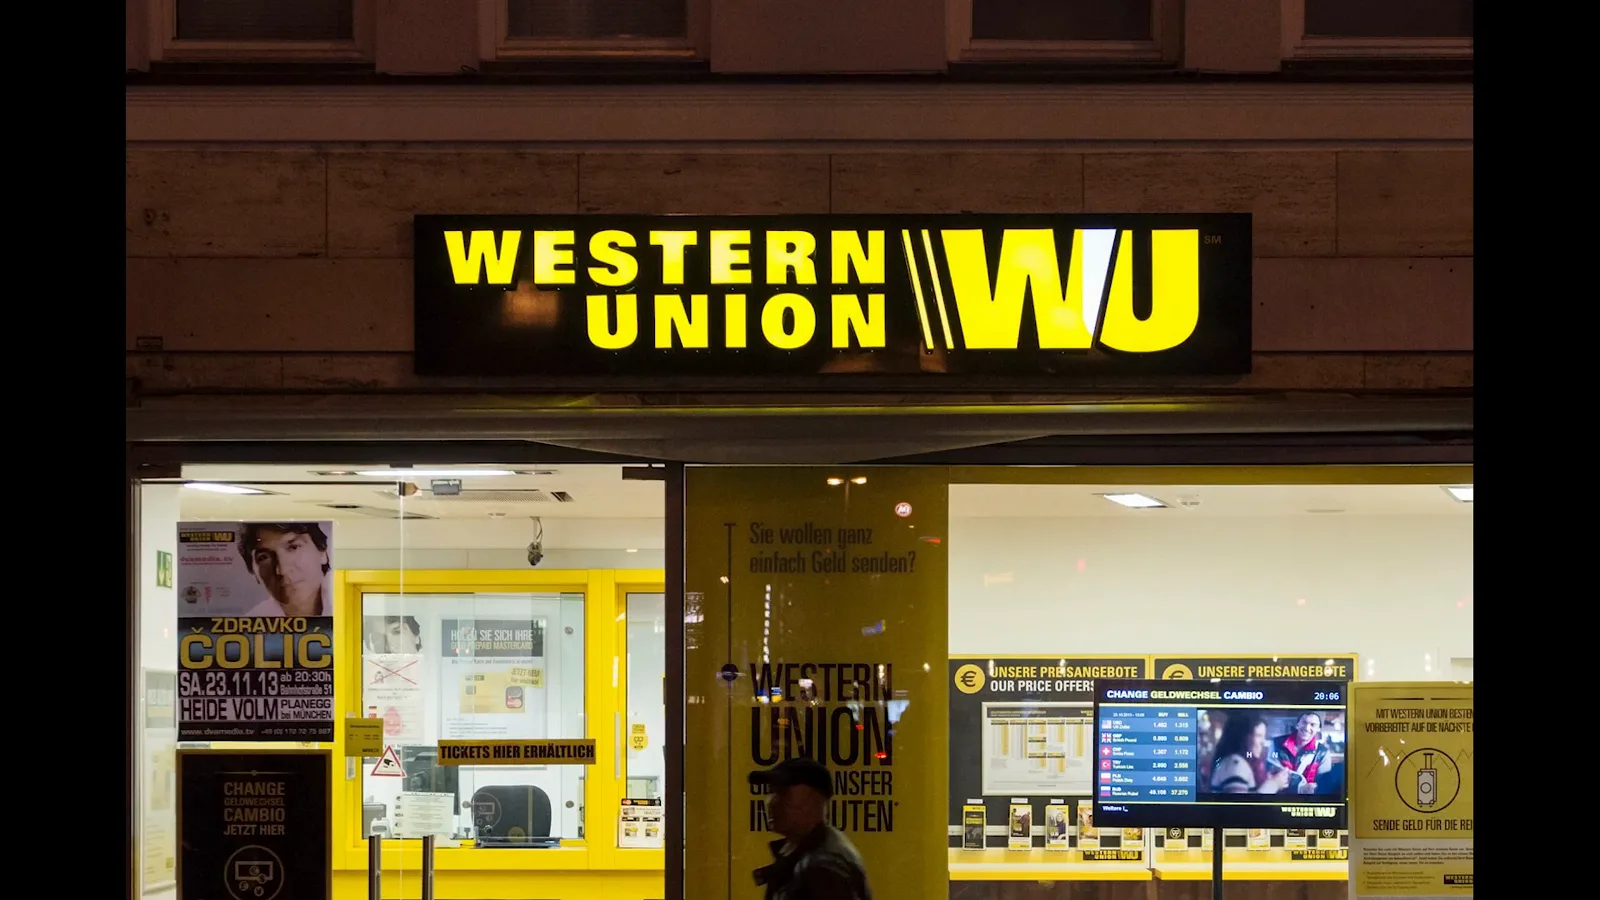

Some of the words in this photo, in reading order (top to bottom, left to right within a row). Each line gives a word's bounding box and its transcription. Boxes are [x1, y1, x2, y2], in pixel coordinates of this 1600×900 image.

[1203, 235, 1222, 245] SM
[444, 229, 885, 286] WESTERN
[941, 228, 1199, 352] WU
[586, 293, 886, 350] UNION
[750, 523, 774, 544] Sie
[780, 523, 832, 544] wollen
[838, 529, 872, 549] ganz
[750, 552, 806, 573] einfach
[812, 551, 846, 573] Geld
[852, 551, 915, 573] senden?
[211, 618, 307, 633] ZDRAVKO
[480, 629, 493, 641] SIE
[495, 629, 513, 641] SICH
[515, 629, 533, 641] IHRE
[180, 626, 332, 670] ČOLIĆ
[494, 641, 533, 650] MASTERCARD
[280, 671, 292, 682] ab
[295, 671, 332, 682] 20:30h
[990, 666, 1037, 678] UNSERE
[1040, 666, 1138, 678] PREISANGEBOTE
[1198, 666, 1244, 679] UNSERE
[1249, 666, 1347, 679] PREISANGEBOTE
[750, 663, 893, 701] WESTERN
[990, 680, 1015, 692] OUR
[1018, 680, 1051, 692] PRICE
[280, 684, 322, 695] Bahnhofstraße
[324, 684, 332, 695] 51
[1107, 690, 1148, 699] CHANGE
[1150, 690, 1222, 700] GELDWECHSEL
[1224, 691, 1264, 700] CAMBIO
[1315, 692, 1340, 700] 20:06
[181, 699, 227, 720] HEIDE
[232, 699, 279, 720] VOLM
[281, 699, 332, 709] PLANEGG
[281, 710, 291, 719] bei
[293, 709, 332, 719] MÜNCHEN
[1376, 709, 1389, 719] MIT
[1390, 709, 1424, 719] WESTERN
[1426, 709, 1448, 719] UNION
[1365, 722, 1410, 732] VORBEREITET
[1411, 722, 1426, 732] AUF
[1427, 722, 1438, 732] DIE
[1438, 719, 1471, 732] NÄCHSTE
[751, 707, 893, 766] UNION
[440, 745, 489, 762] TICKETS
[493, 744, 521, 761] HIER
[524, 741, 595, 762] ERHÄLTLICH
[223, 781, 286, 796] CHANGE
[223, 798, 286, 806] GELDWECHSEL
[223, 807, 286, 822] CAMBIO
[223, 824, 257, 836] JETZT
[259, 824, 286, 836] HIER
[1373, 820, 1399, 831] SENDE
[1402, 820, 1423, 831] GELD
[1426, 817, 1442, 831] FÜR
[1444, 820, 1458, 831] DIE
